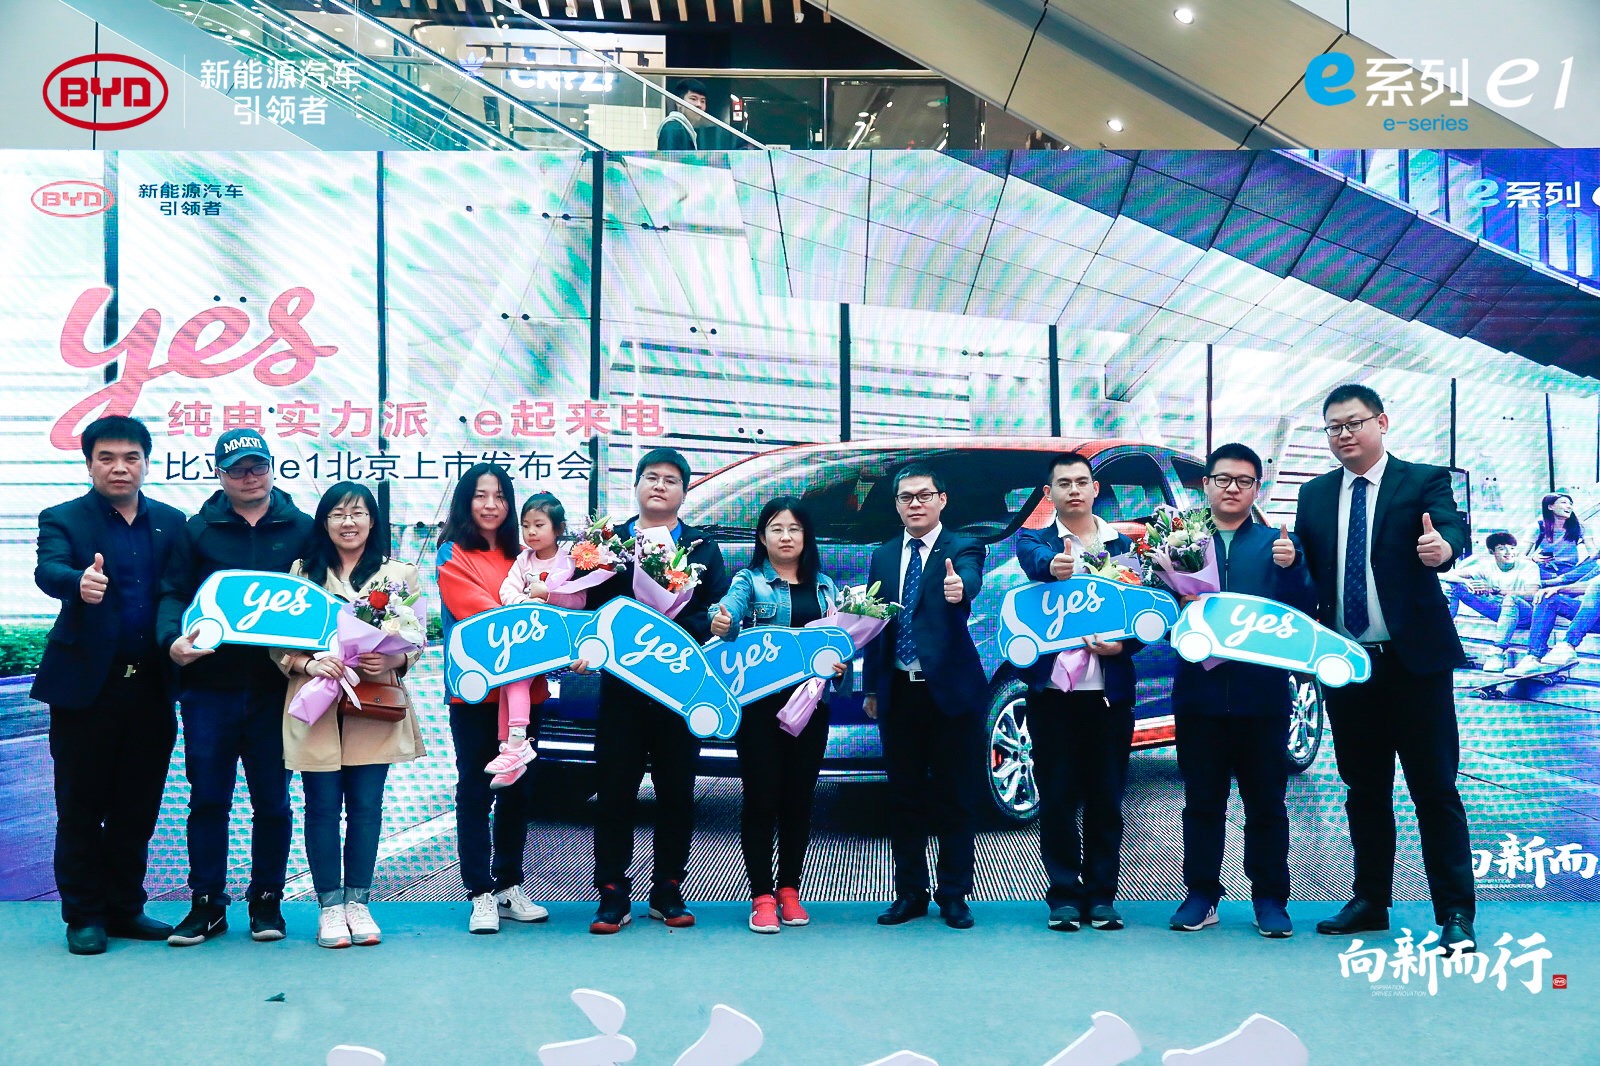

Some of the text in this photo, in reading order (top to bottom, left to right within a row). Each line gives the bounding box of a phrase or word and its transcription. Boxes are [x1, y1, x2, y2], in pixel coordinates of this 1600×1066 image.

[41, 191, 102, 207] BYD
[138, 182, 244, 199] 新能源汽车
[159, 201, 222, 216] 引领者
[50, 286, 338, 450] yes
[167, 399, 664, 438] 纯电实力派 e起来电
[165, 449, 593, 481] 比e1北京上市发布会
[223, 436, 263, 454] MMXVI
[236, 581, 312, 631] yes
[1041, 581, 1106, 639] yes
[1224, 604, 1298, 647] yes
[487, 610, 548, 673] yes
[620, 623, 695, 673] yes
[721, 632, 782, 694] yes
